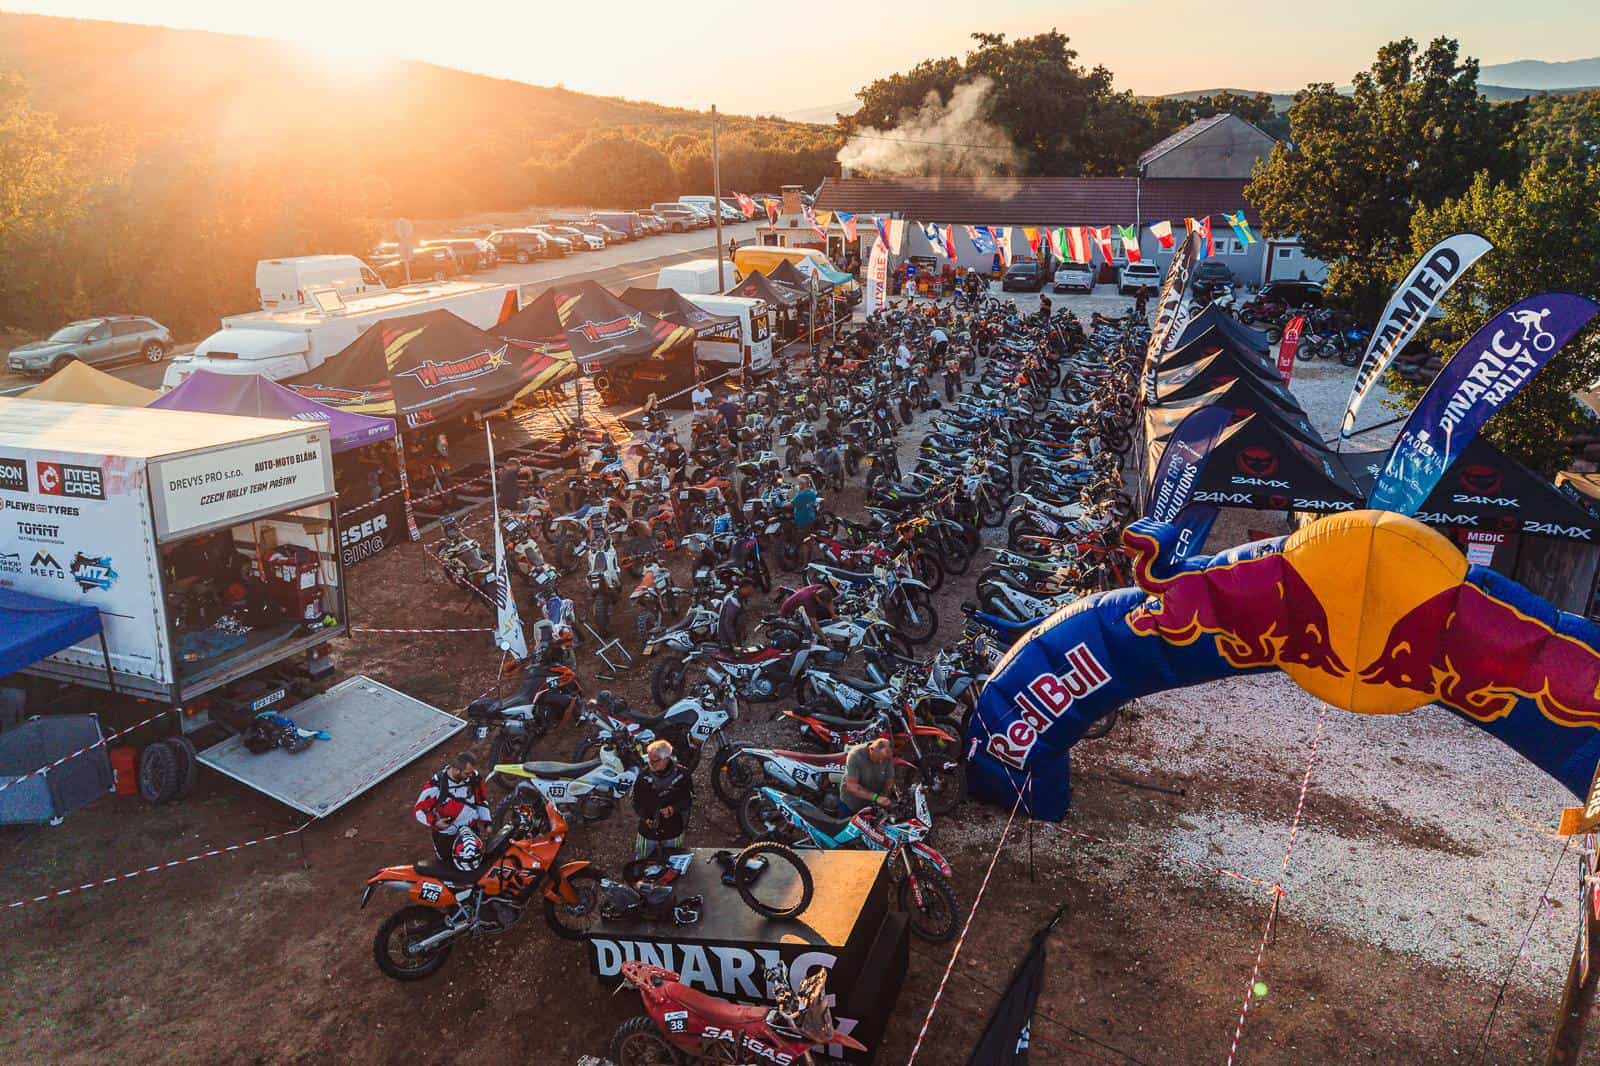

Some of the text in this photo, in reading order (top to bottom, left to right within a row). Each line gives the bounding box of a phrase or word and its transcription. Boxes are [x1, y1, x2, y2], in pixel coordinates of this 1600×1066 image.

[1439, 329, 1522, 433] DINARIC
[1482, 348, 1538, 406] RALLY
[254, 457, 296, 473] AUTO-MOTO
[63, 468, 100, 482] INTER
[169, 469, 244, 492] DREVYS PRO s.r.o.
[1231, 476, 1290, 489] 24MX
[65, 481, 101, 496] CARS
[200, 490, 225, 506] CZECH
[226, 486, 248, 501] RALLY
[249, 482, 268, 495] TEAM
[1153, 454, 1184, 523] FUTURE GPS
[1165, 463, 1198, 524] SOLUTIONS
[1193, 490, 1253, 504] 24MX
[1293, 498, 1355, 511] 24MX
[1453, 494, 1520, 508] 24MX
[5, 500, 80, 517] PLEWS TYRES
[1413, 511, 1479, 526] 24MX
[1467, 531, 1504, 543] MEDIC
[1522, 520, 1592, 540] 24MX
[30, 568, 65, 579] MEFO
[987, 641, 1113, 771] Red Bull
[670, 1020, 684, 1030] 38
